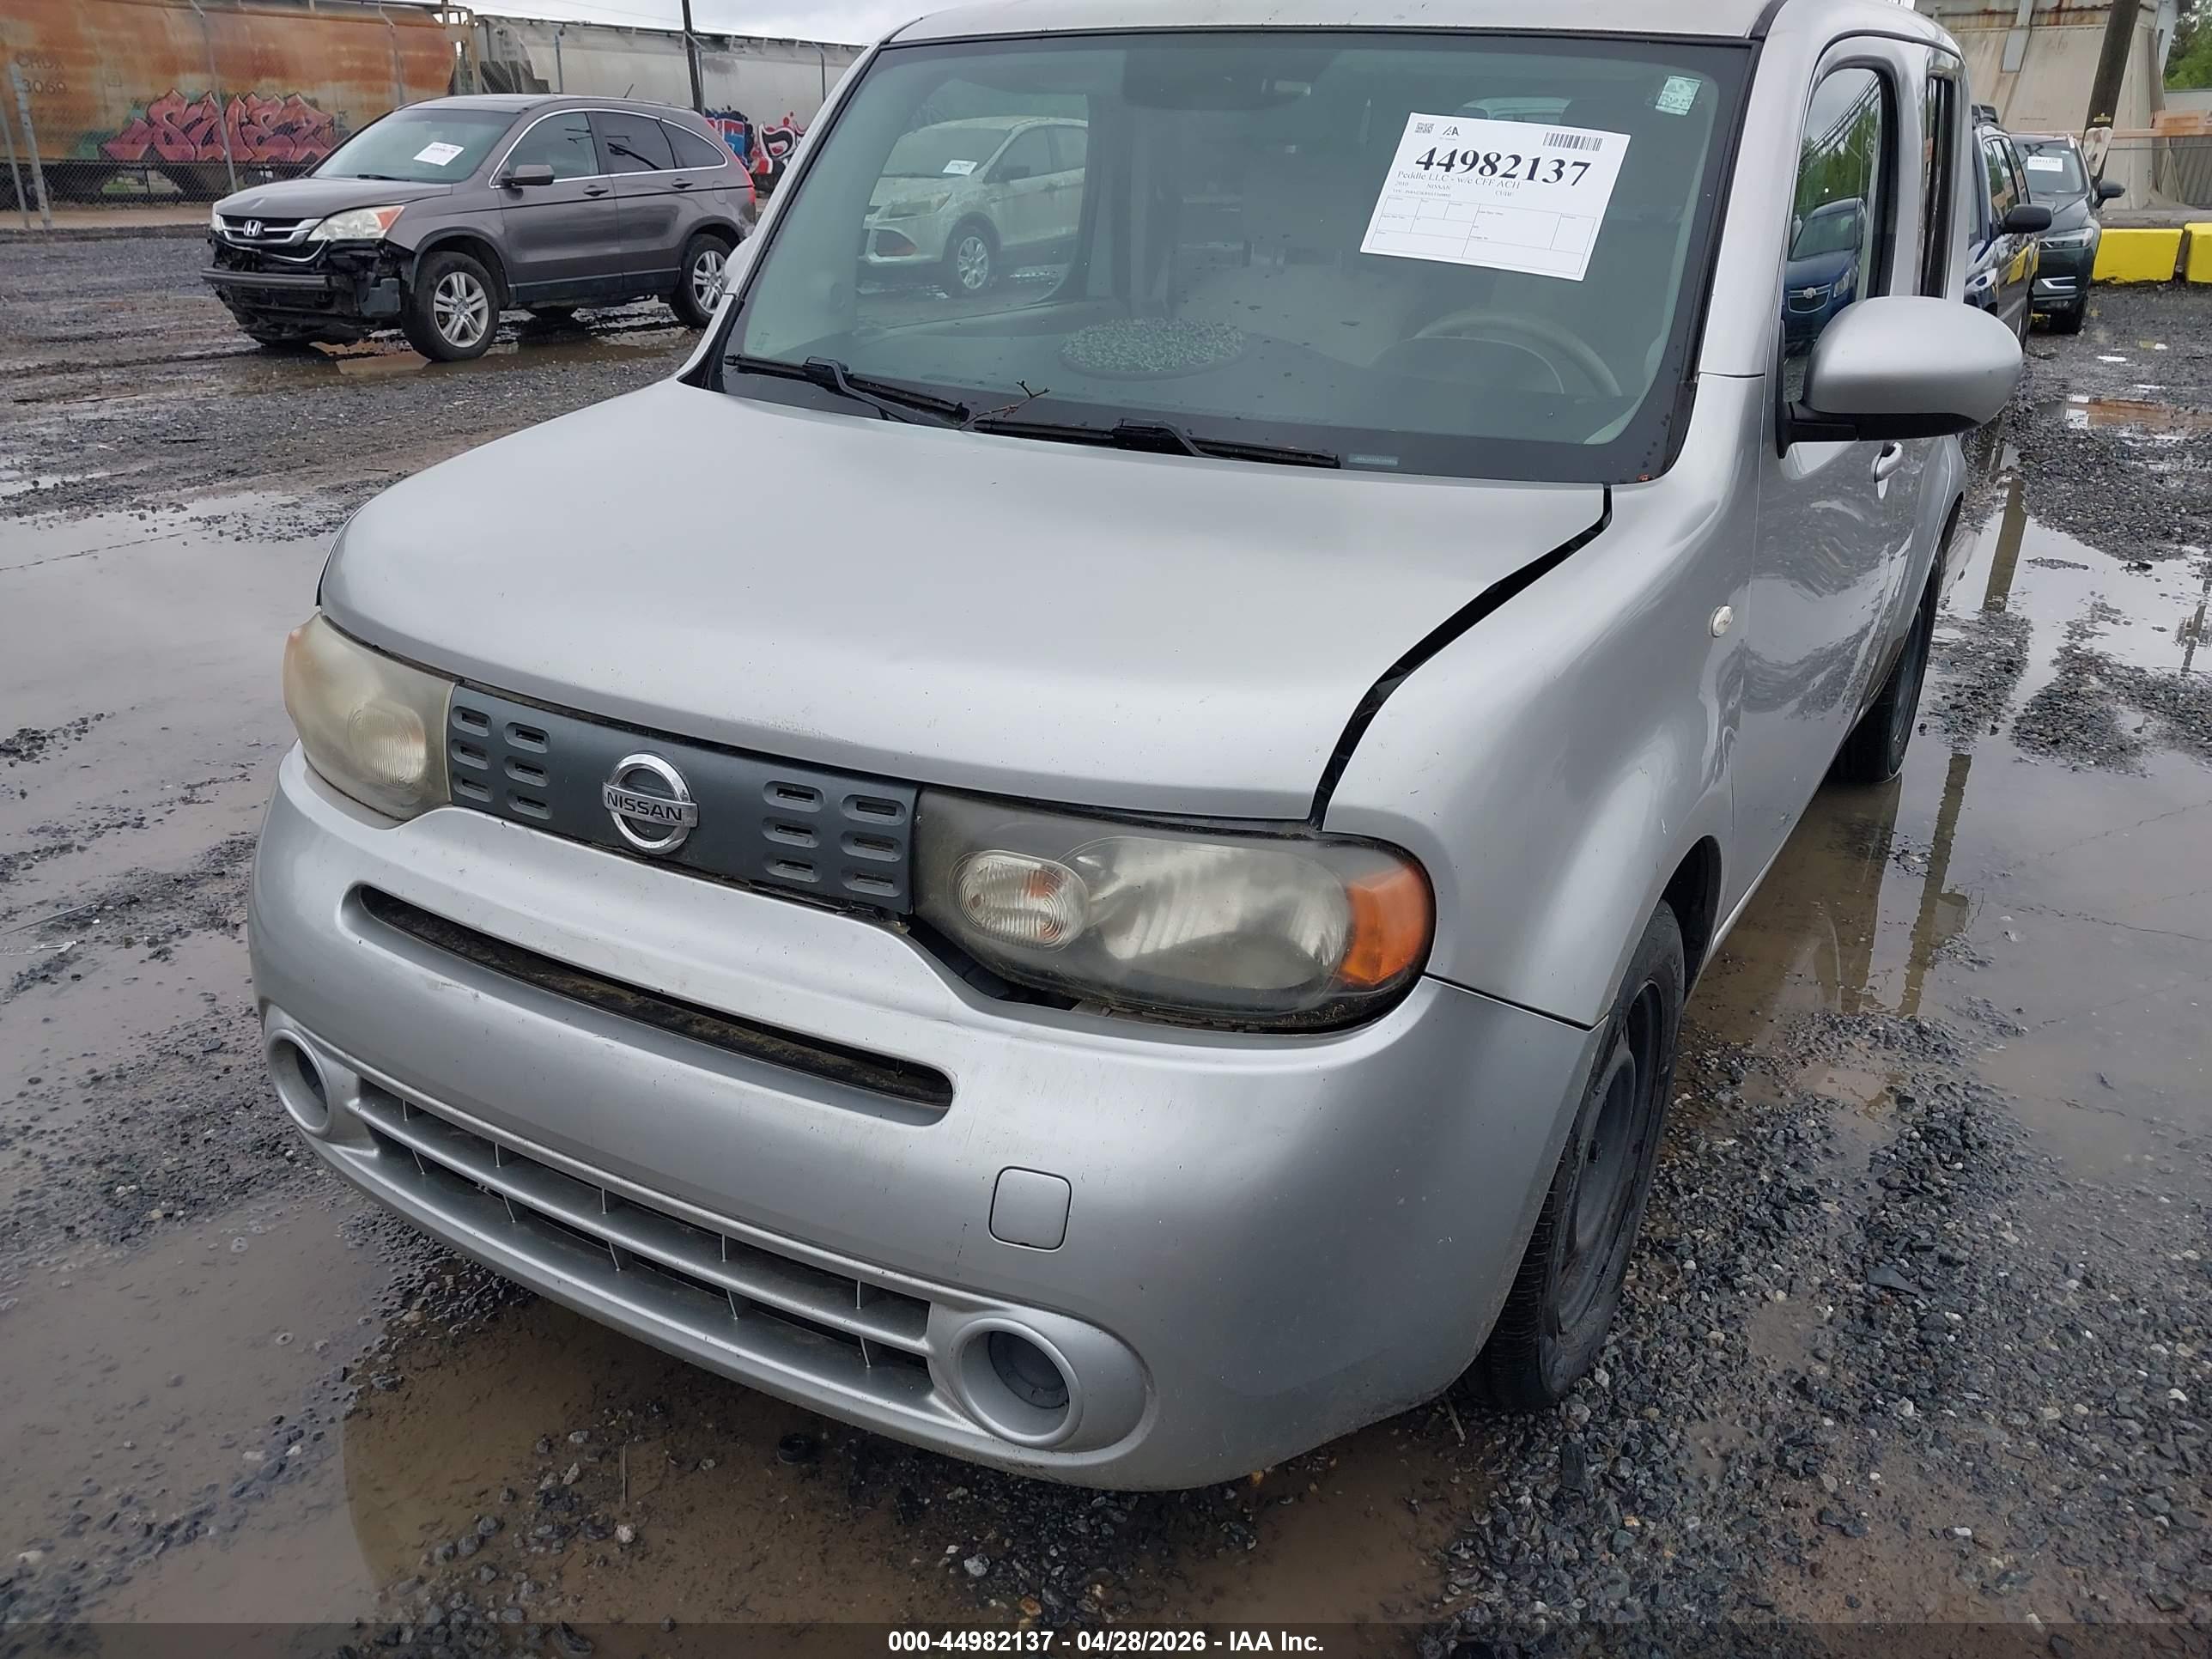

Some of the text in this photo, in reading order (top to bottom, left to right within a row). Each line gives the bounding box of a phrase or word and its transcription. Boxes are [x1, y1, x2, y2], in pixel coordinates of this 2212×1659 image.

[1397, 171, 1427, 180] Peddle
[1428, 173, 1449, 182] LLC
[1497, 180, 1520, 189] ACH
[1415, 146, 1591, 186] 44982137
[607, 792, 682, 821] NISSAN
